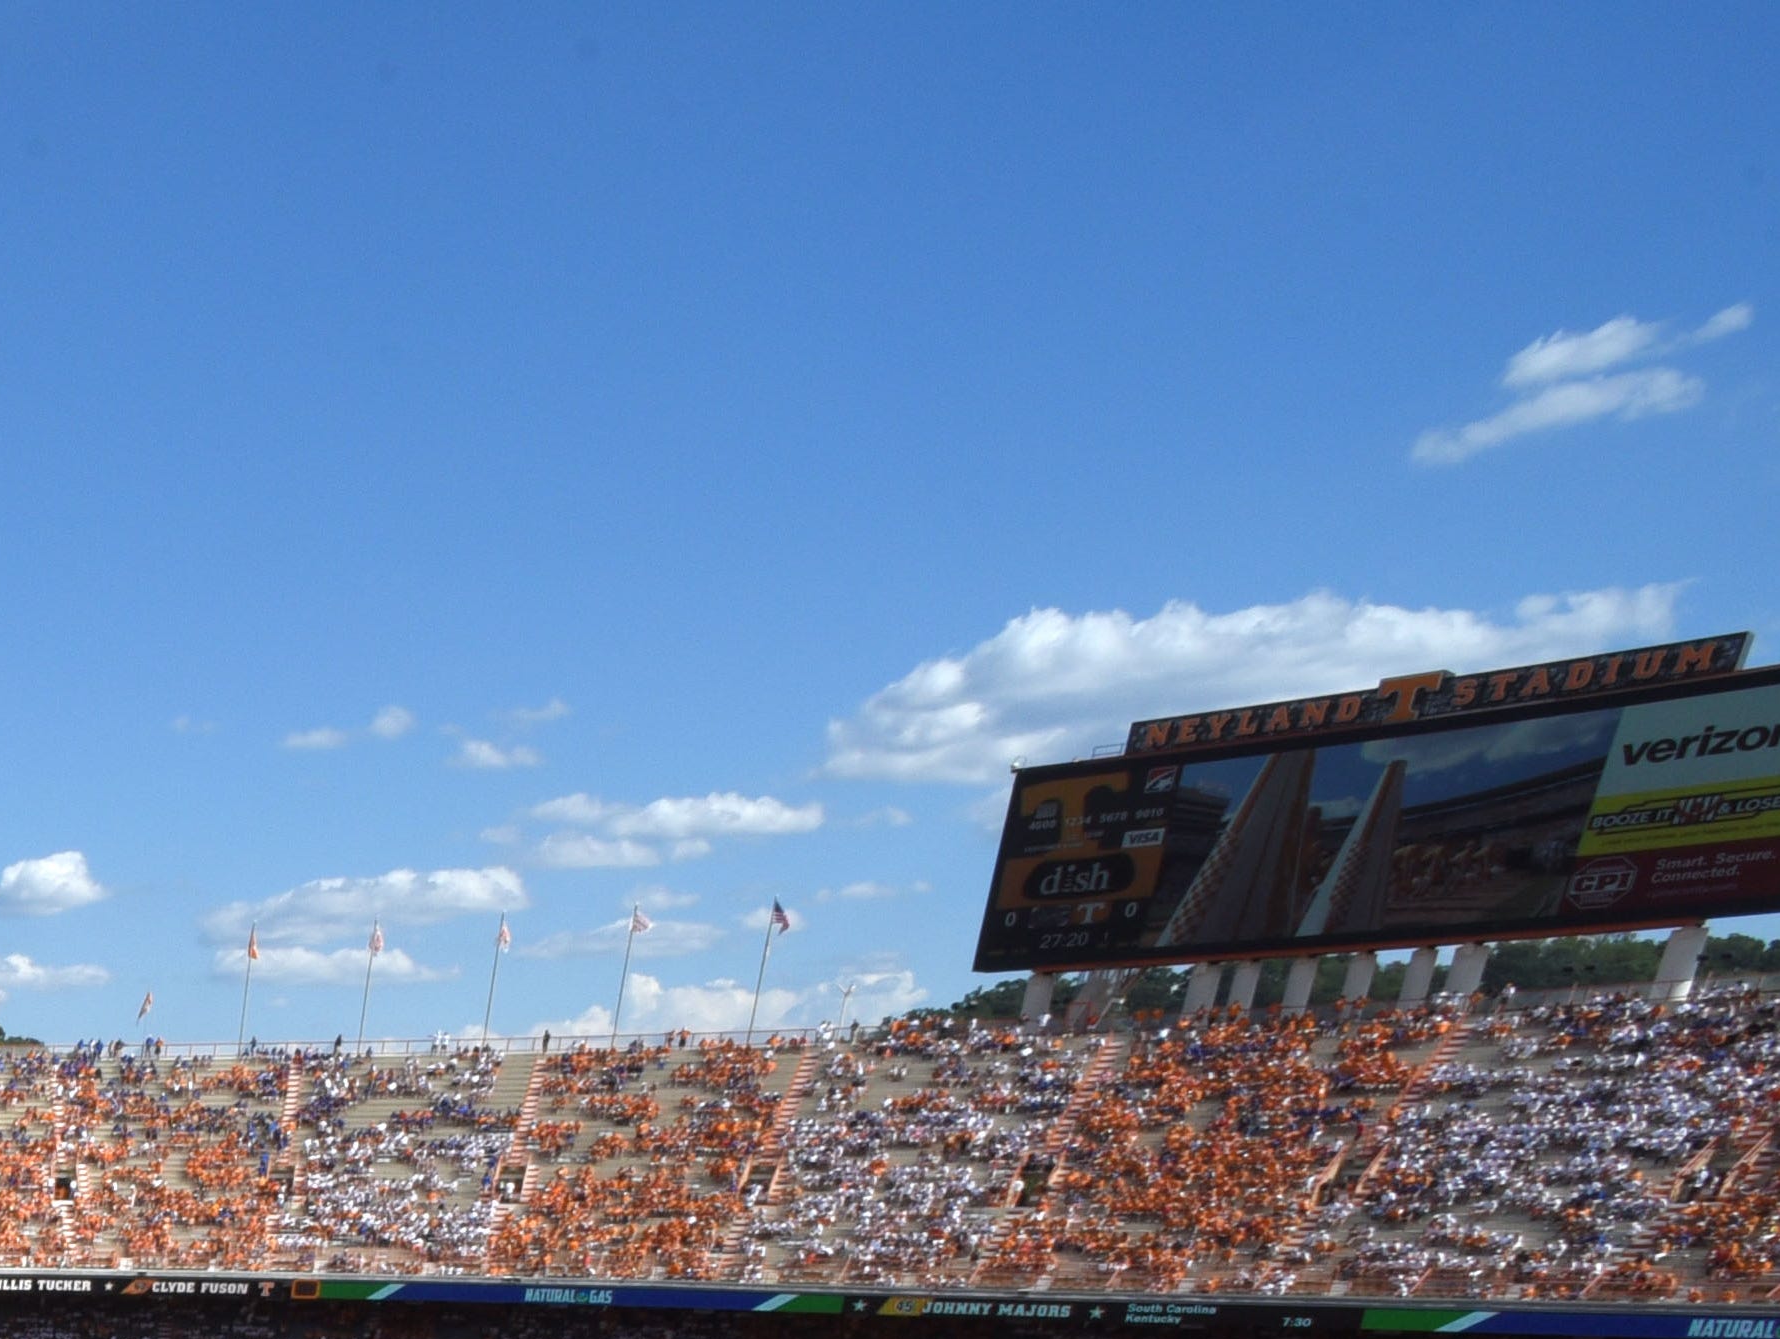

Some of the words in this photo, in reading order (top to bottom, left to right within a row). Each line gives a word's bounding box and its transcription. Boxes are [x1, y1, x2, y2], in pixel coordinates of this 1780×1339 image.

[1144, 694, 1361, 749] NEYLAND
[1451, 642, 1717, 705] STADIUM
[1593, 808, 1651, 828] BOOZE
[1128, 832, 1160, 845] VISA
[1656, 855, 1708, 871] Smart.
[1715, 848, 1777, 865] Secure.
[1040, 862, 1110, 896] dish
[1651, 864, 1741, 885] Connected.
[1124, 902, 1138, 918] 0
[37, 1279, 92, 1292] TUCKER
[152, 1281, 195, 1294] CLYDE
[200, 1282, 248, 1295] FUSON
[524, 1287, 576, 1303] NATURAL
[589, 1290, 613, 1304] GAS
[922, 1302, 992, 1316] JOHNNY
[997, 1303, 1072, 1317] MAJORS
[1127, 1303, 1163, 1313] South
[1166, 1304, 1217, 1315] Carolina
[1125, 1313, 1182, 1325] Kentucky
[1282, 1316, 1313, 1328] 7:30
[1686, 1318, 1775, 1339] NATURAL
